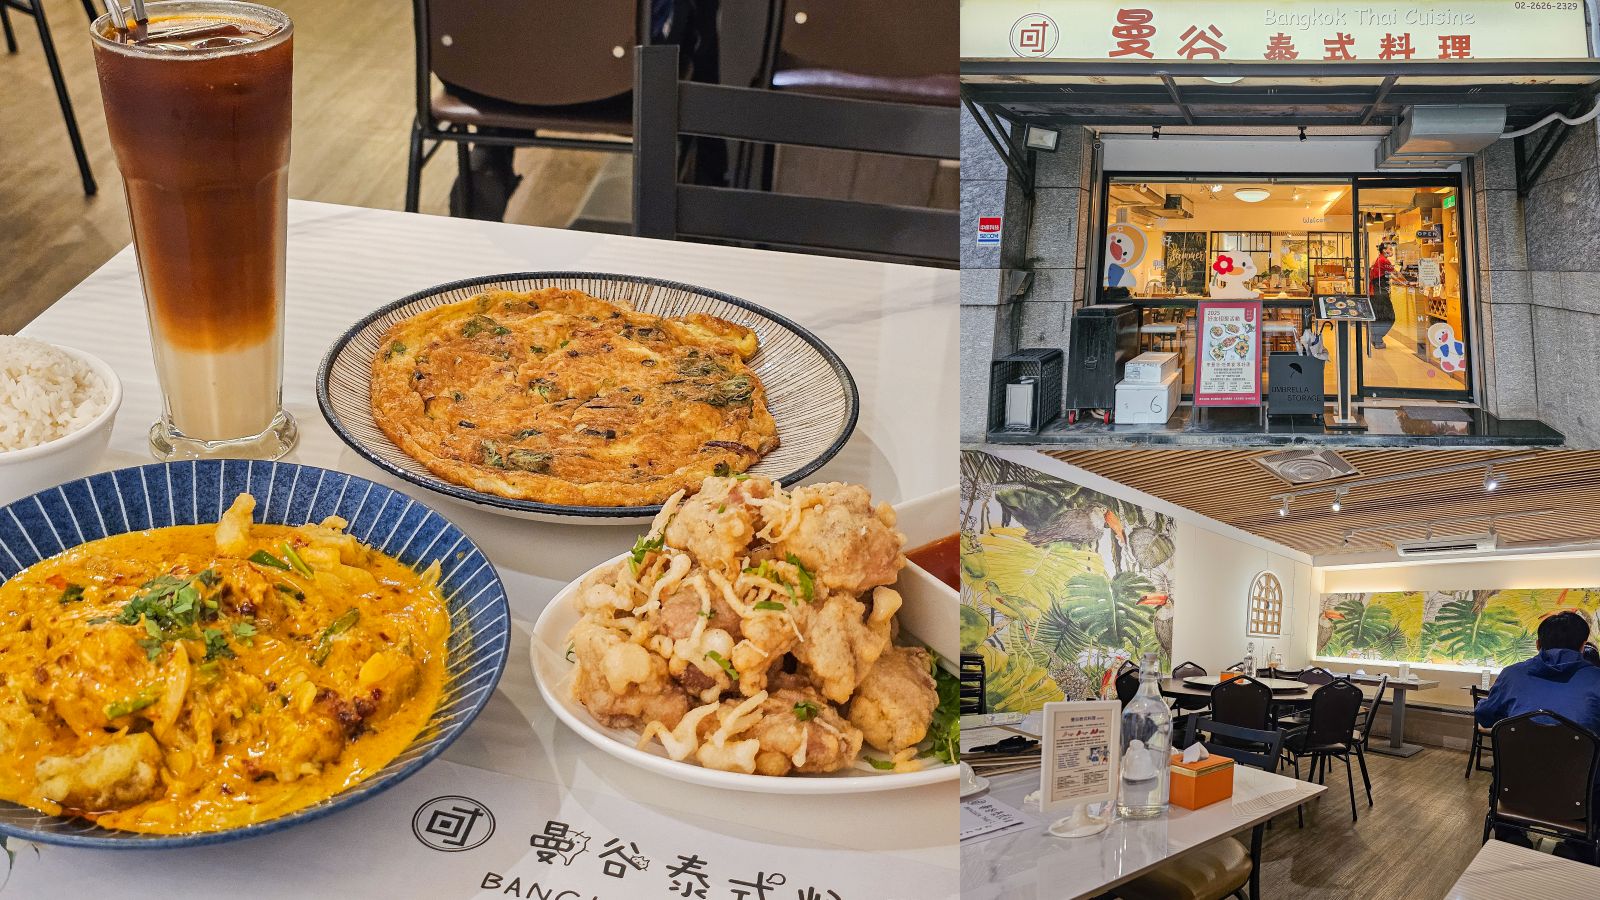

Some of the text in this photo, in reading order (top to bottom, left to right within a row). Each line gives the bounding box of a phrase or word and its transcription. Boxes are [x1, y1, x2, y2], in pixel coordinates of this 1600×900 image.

[1514, 1, 1578, 10] 02-2626-2329
[1264, 8, 1477, 31] Bangkok Thai Cuisine
